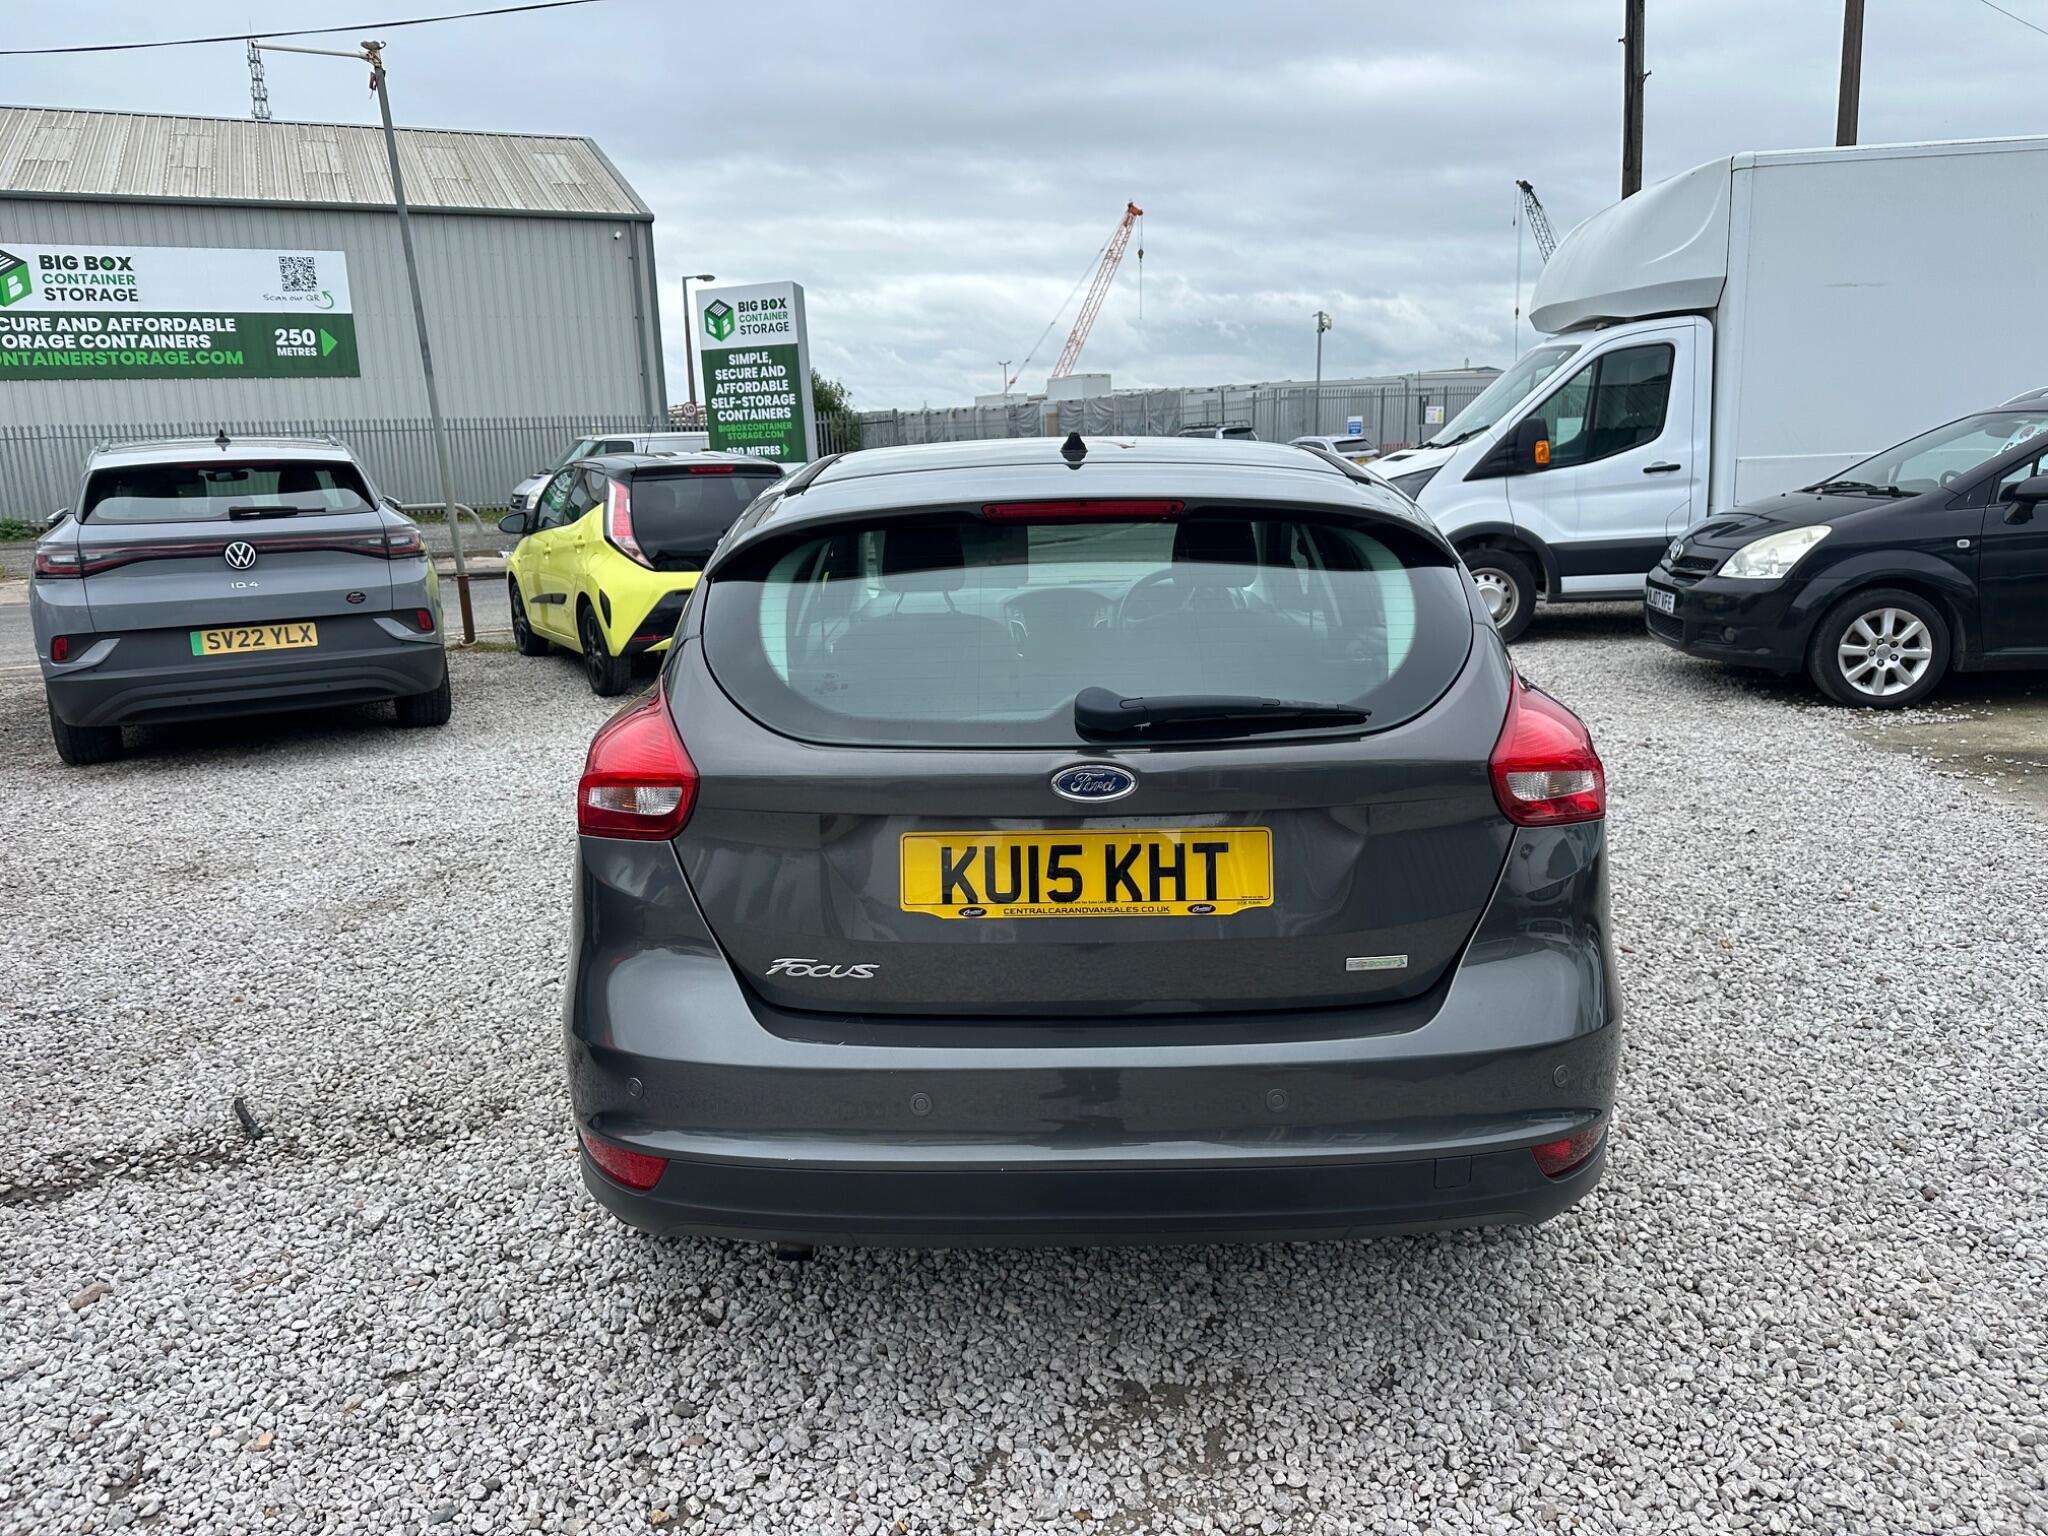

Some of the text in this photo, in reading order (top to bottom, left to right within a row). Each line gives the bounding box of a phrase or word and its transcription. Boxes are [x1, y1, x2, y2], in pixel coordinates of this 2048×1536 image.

[38, 254, 134, 271] BIG BOX
[41, 273, 136, 286] CONTAINER
[44, 287, 139, 302] STORAGE
[738, 298, 787, 313] BIG BOX
[56, 317, 102, 332] AND
[107, 317, 236, 332] AFFORDABLE
[739, 311, 788, 324] CONTAINER
[740, 321, 790, 336] STORAGE
[80, 334, 212, 349] CONTAINERS
[274, 328, 316, 346] 250
[0, 350, 244, 366] NTAINERSTORAGE.COM
[276, 347, 318, 357] METRES
[728, 352, 772, 366] SIMPLE,
[715, 365, 786, 381] SECURE AND
[716, 380, 789, 395] AFFORDABLE
[711, 394, 796, 409] SELF-STORAGE
[717, 407, 792, 421] CONTAINERS
[717, 422, 793, 433] BIGBOXCONTAINER
[727, 431, 785, 441] STORAGE.COM
[747, 445, 781, 456] METRES
[206, 624, 313, 650] SV22 YLX
[1070, 772, 1117, 792] Ford
[941, 842, 1229, 904] KU15 KHT
